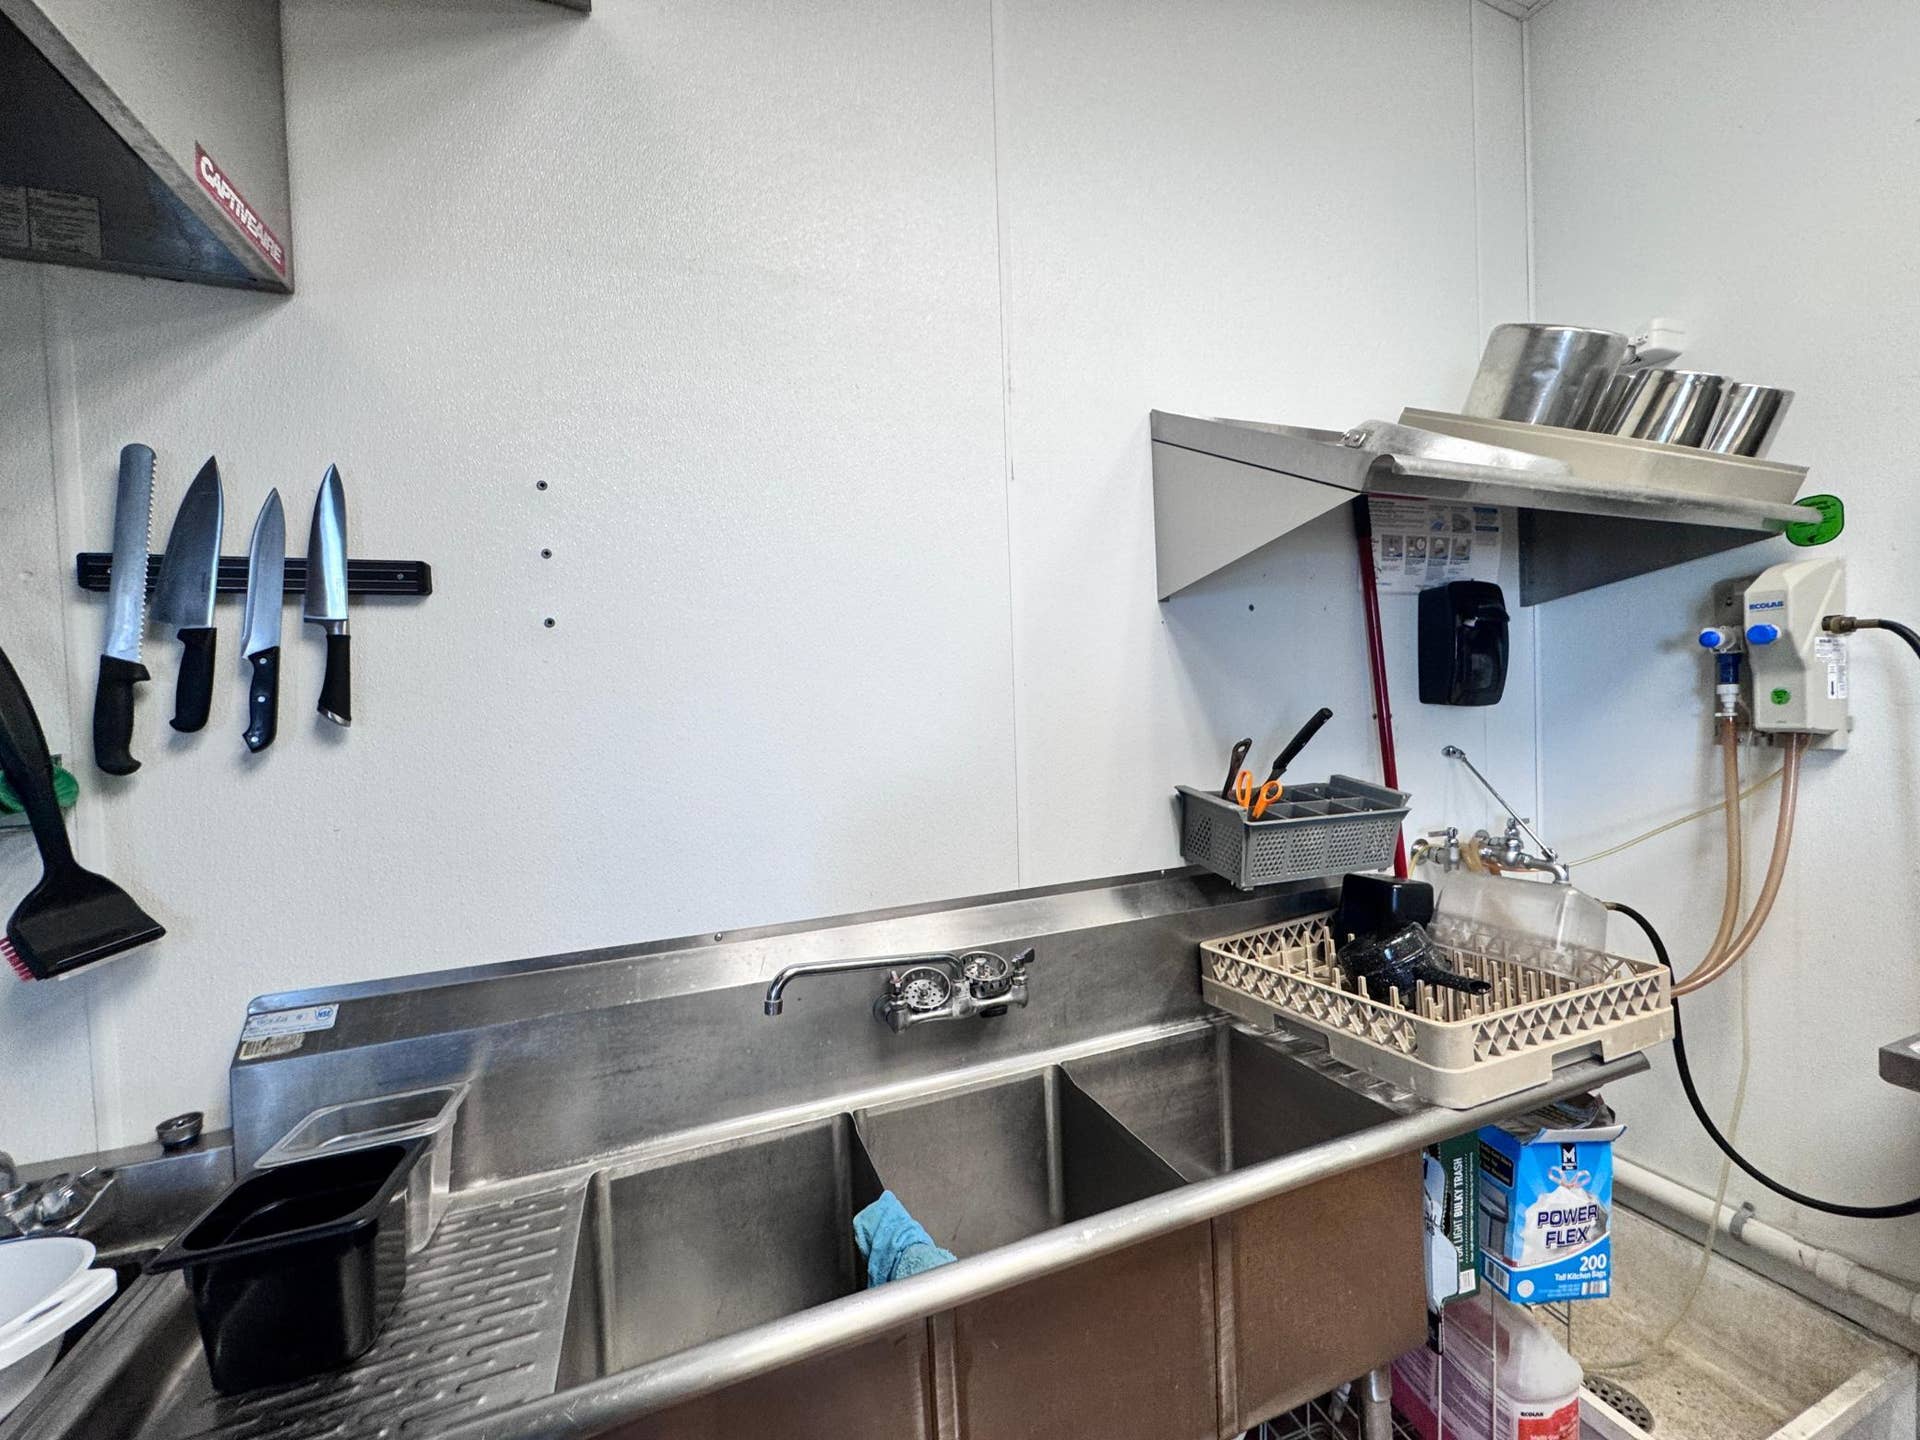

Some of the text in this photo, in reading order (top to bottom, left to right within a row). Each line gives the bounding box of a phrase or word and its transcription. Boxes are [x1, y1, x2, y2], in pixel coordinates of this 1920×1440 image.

[200, 156, 282, 265] CAPTIVEAIRE
[1749, 600, 1785, 610] ECOLAB
[1453, 1157, 1464, 1189] TRASH
[1453, 1189, 1464, 1218] BULKY
[1537, 1204, 1599, 1229] POWER
[1453, 1219, 1464, 1245] LIGHT
[1545, 1225, 1590, 1248] FLEX
[1579, 1253, 1607, 1272] 200
[1554, 1273, 1567, 1281] Tall
[1567, 1271, 1592, 1281] Kitchen
